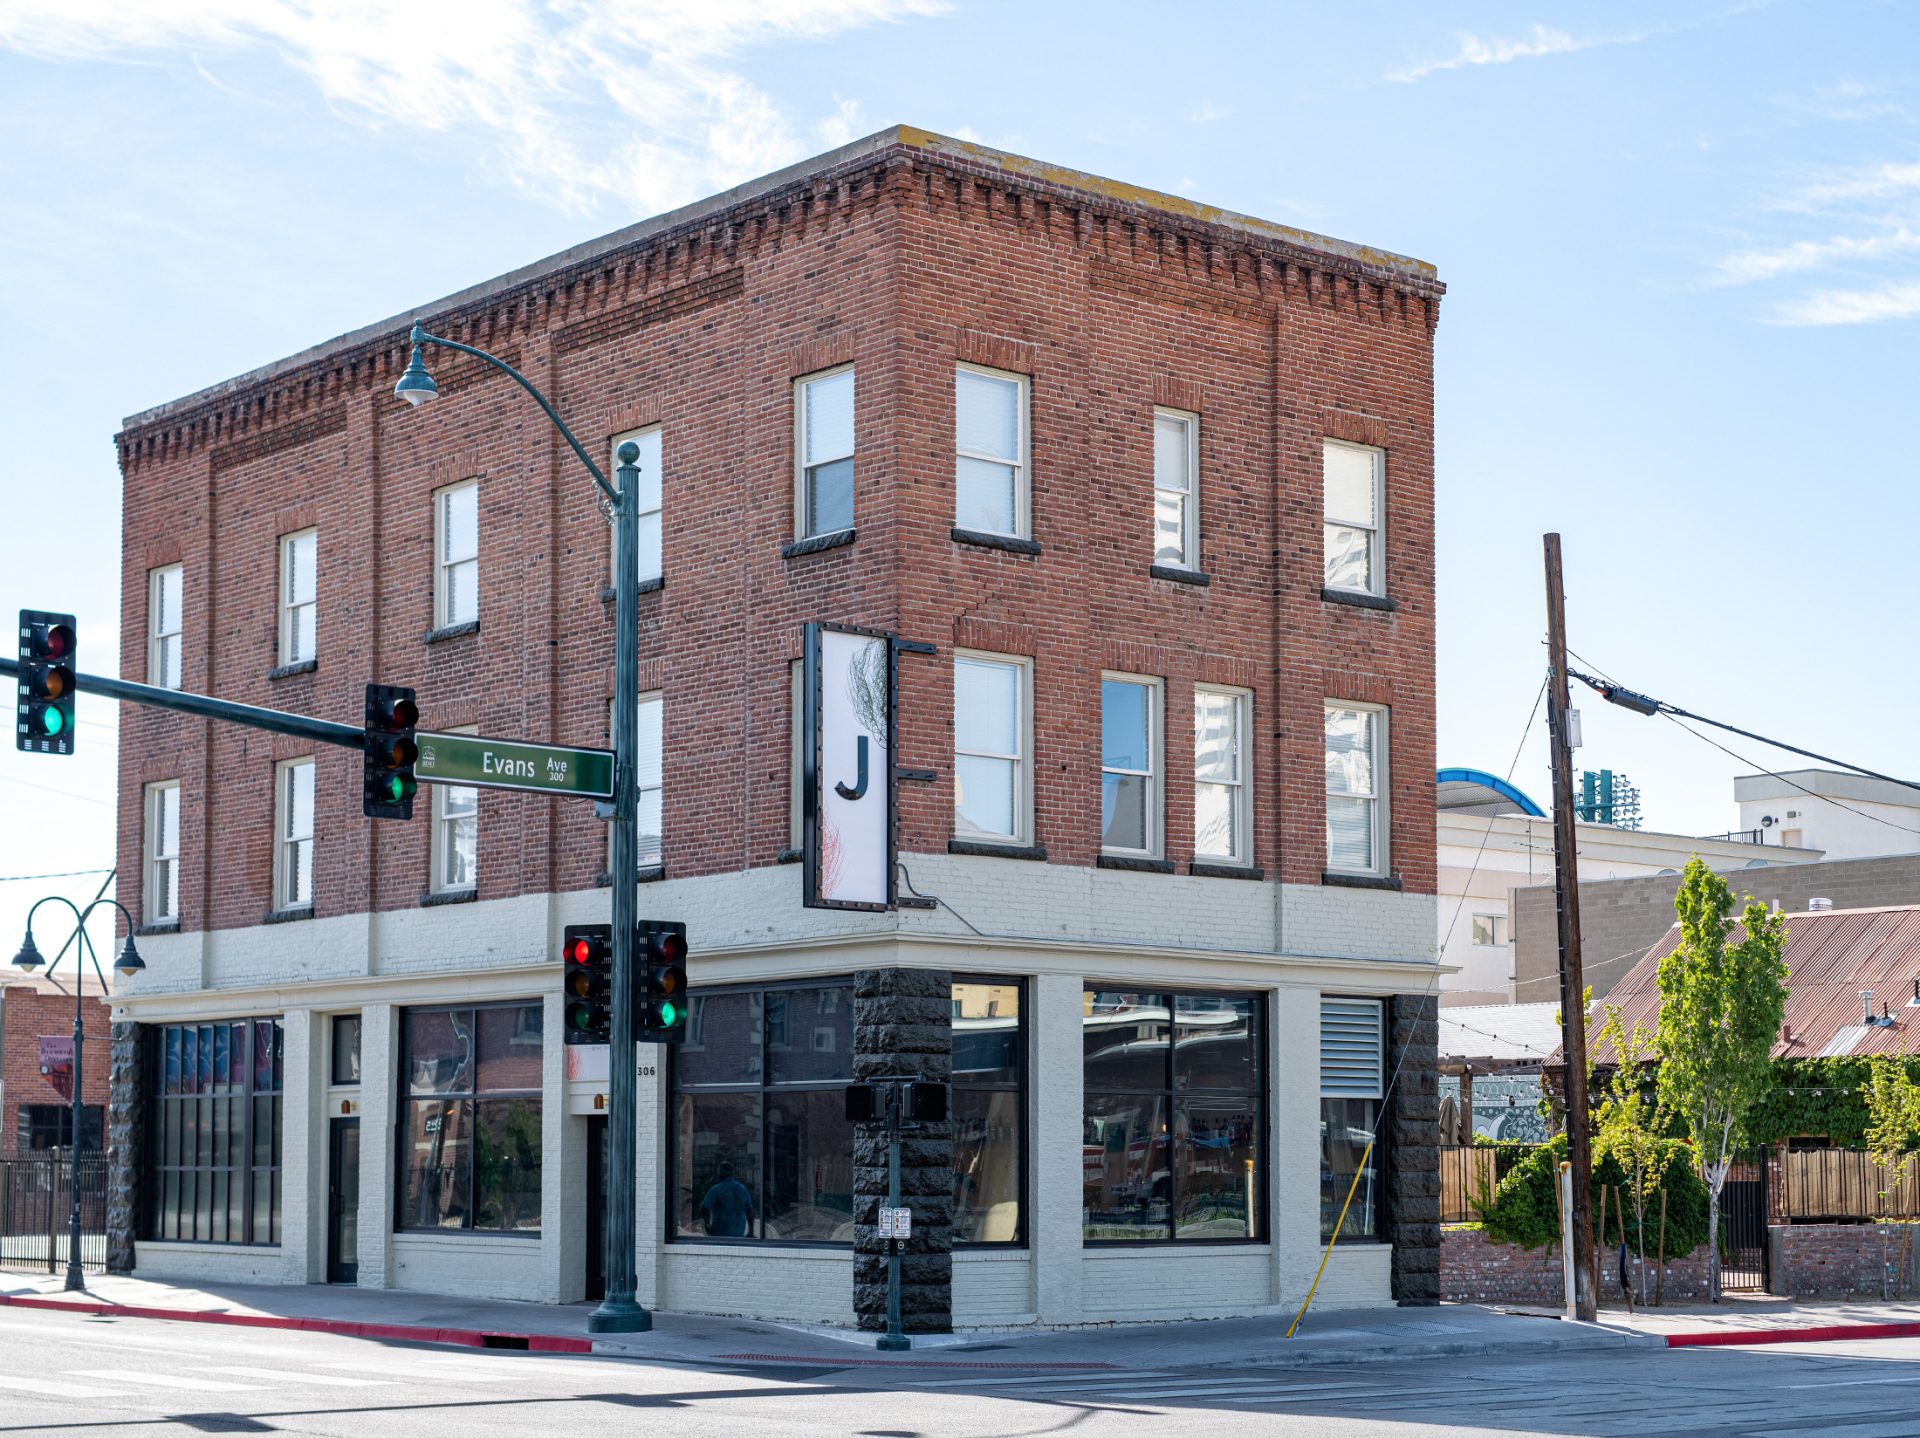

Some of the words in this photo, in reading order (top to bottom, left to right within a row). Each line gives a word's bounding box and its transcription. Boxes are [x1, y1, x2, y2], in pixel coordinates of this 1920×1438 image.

[483, 751, 535, 778] Evans
[546, 757, 567, 772] Ave
[835, 735, 868, 801] J
[549, 772, 564, 782] 300
[637, 1066, 656, 1076] 306
